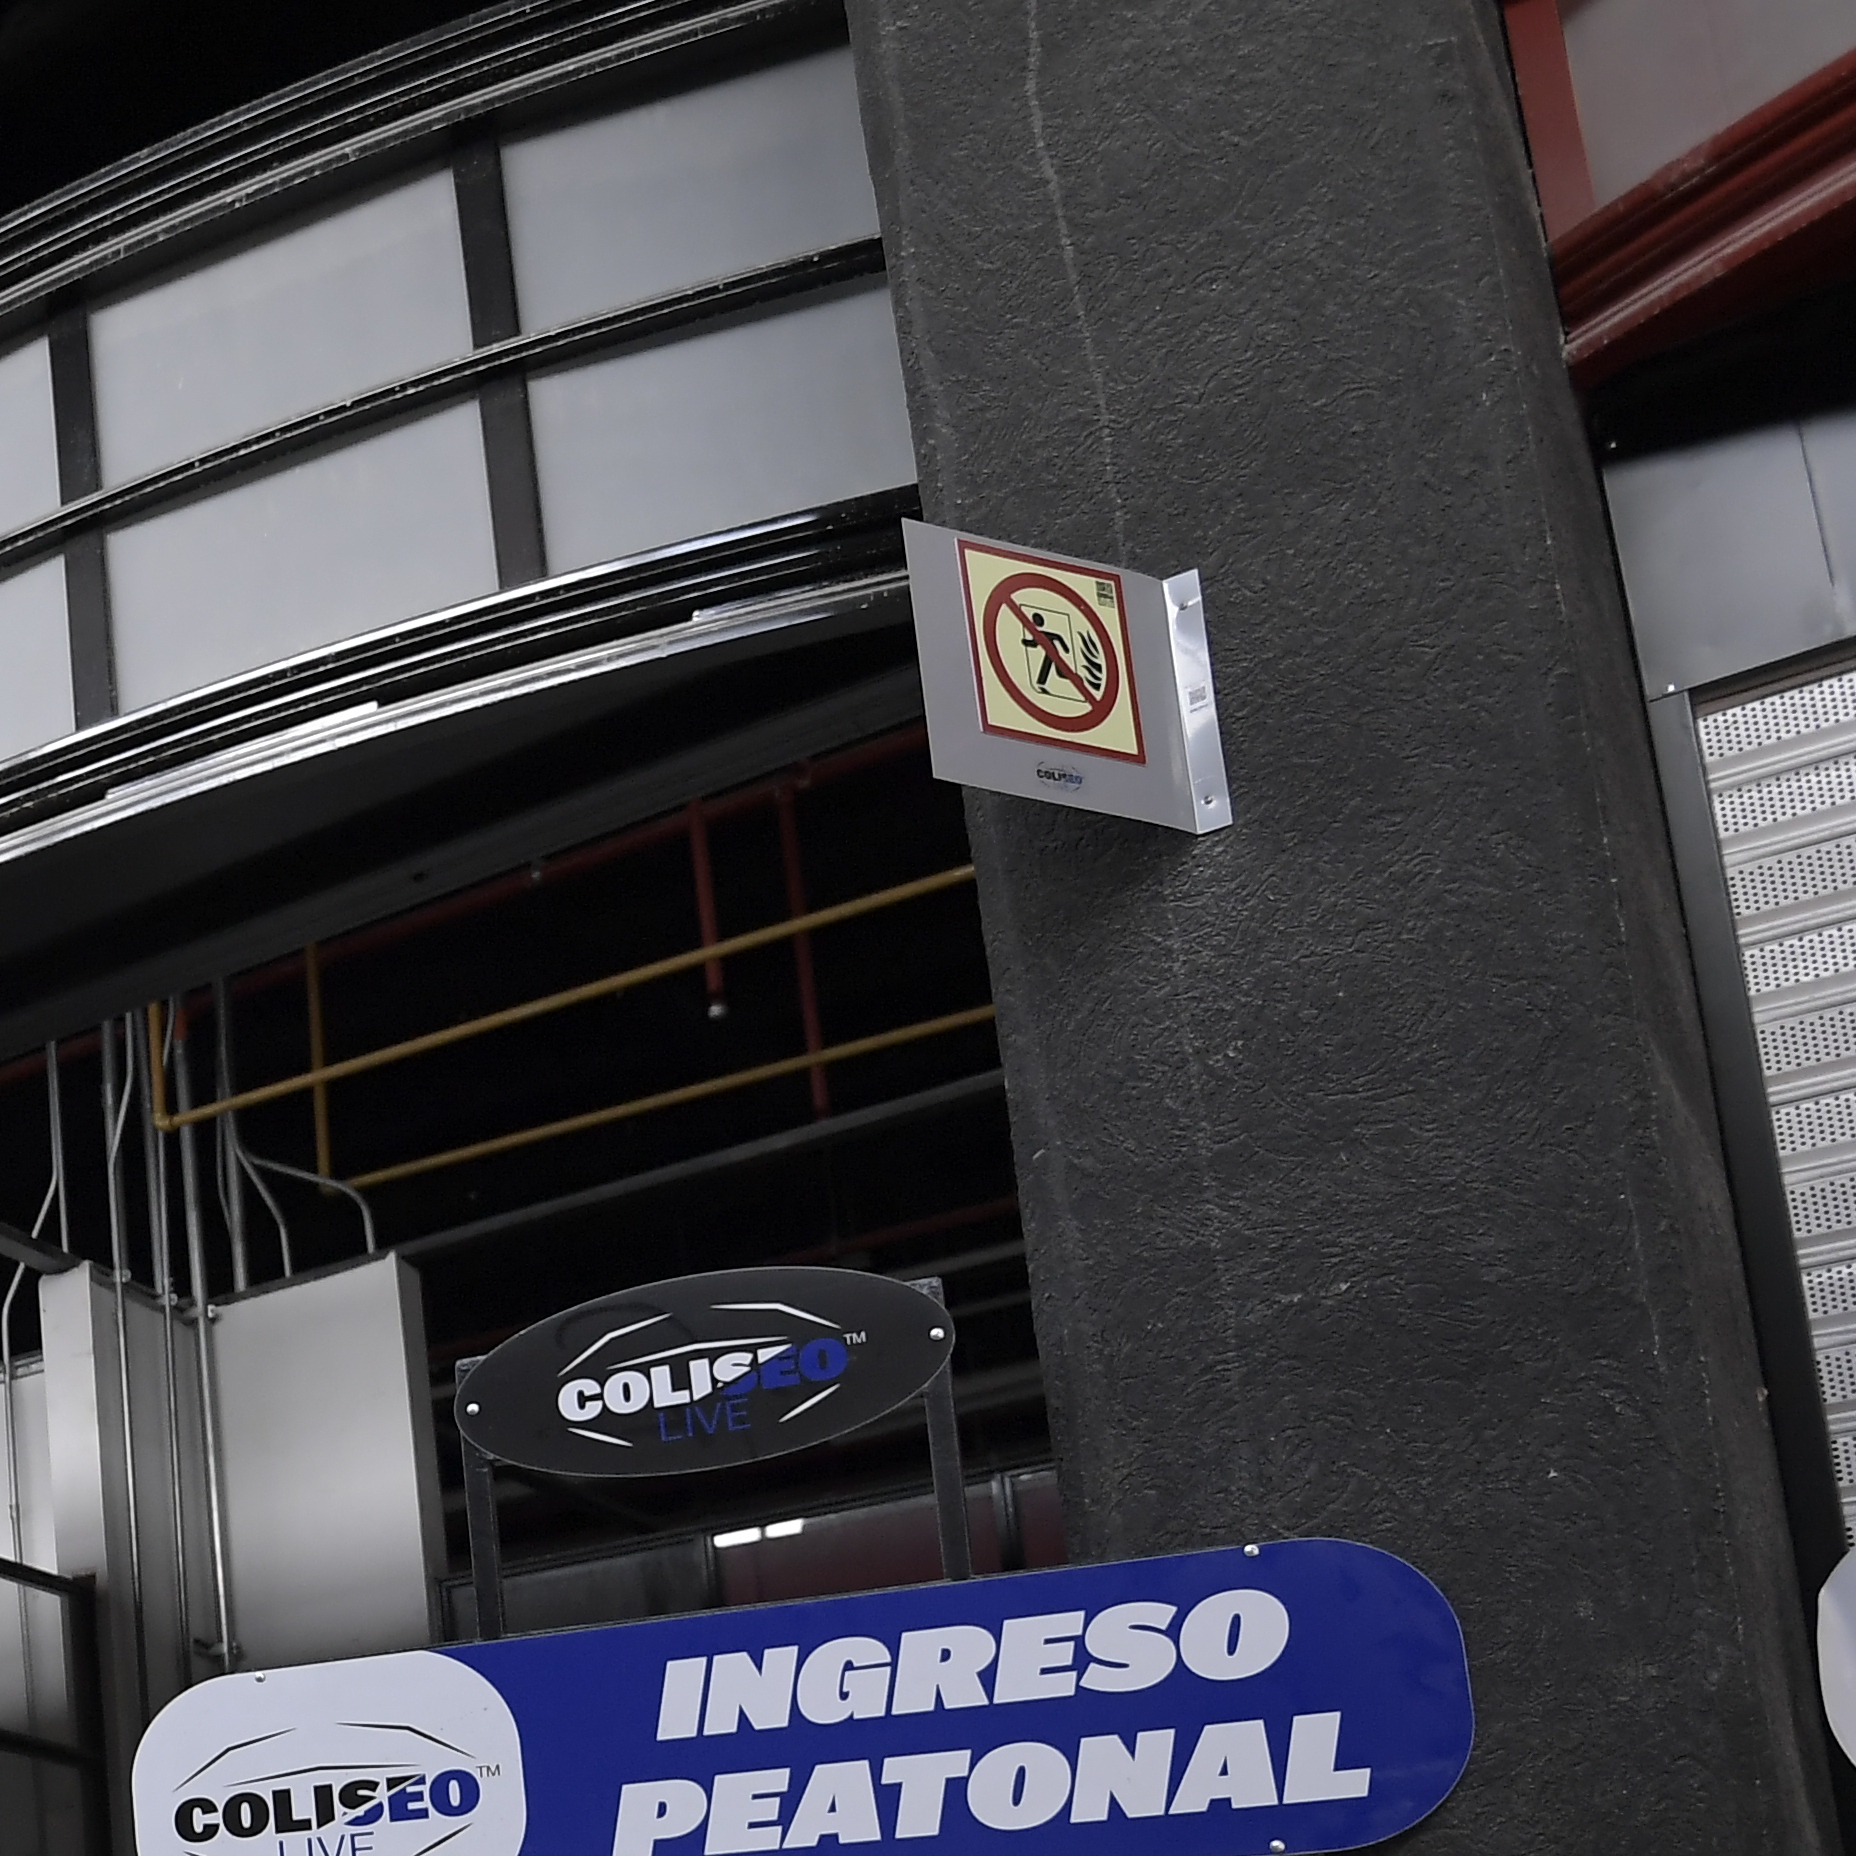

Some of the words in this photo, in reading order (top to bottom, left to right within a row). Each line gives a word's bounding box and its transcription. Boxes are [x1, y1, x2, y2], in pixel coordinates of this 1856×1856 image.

[557, 1338, 848, 1422] COLISEO
[658, 1398, 751, 1442] LIVE
[655, 1588, 1290, 1741] INGRESO
[173, 1768, 481, 1844] COLISEO
